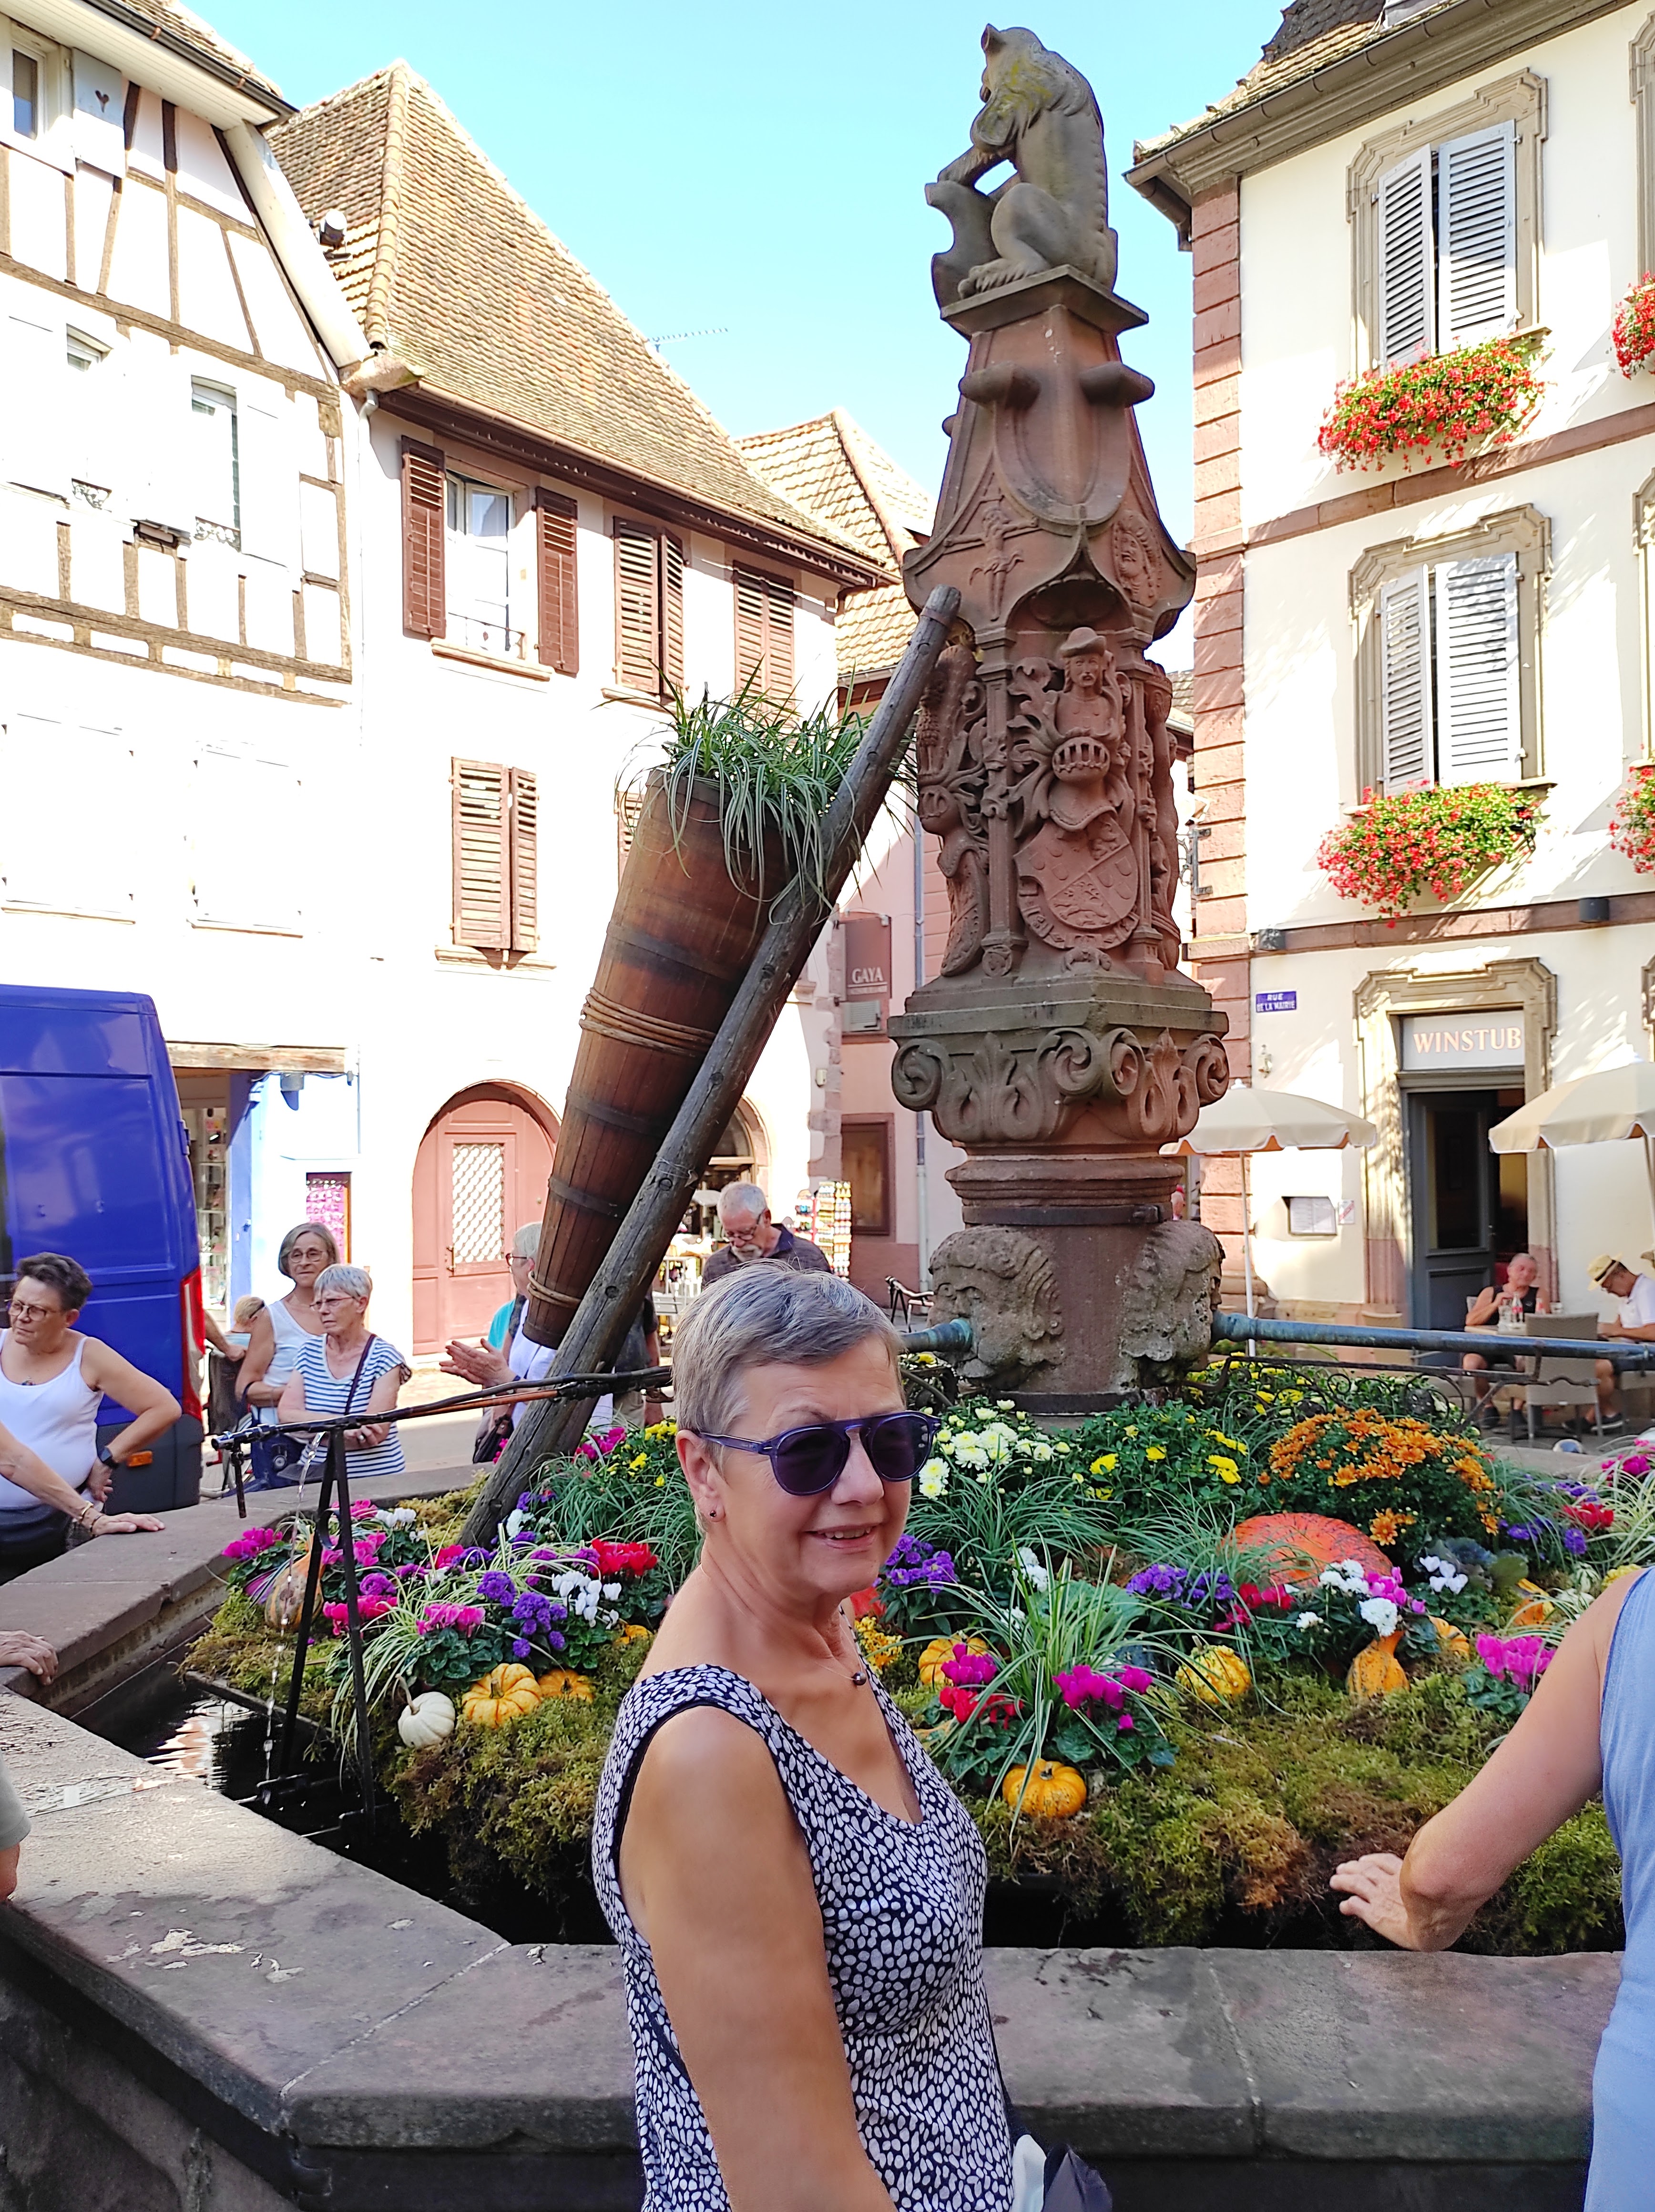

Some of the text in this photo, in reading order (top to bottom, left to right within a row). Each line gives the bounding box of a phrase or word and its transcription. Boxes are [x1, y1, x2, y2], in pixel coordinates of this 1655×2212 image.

[851, 966, 884, 984] GAYA
[1267, 993, 1284, 1001] RUE
[1257, 1003, 1264, 1012] DE
[1265, 1003, 1273, 1011] LA
[1413, 1026, 1522, 1054] WINSTUB
